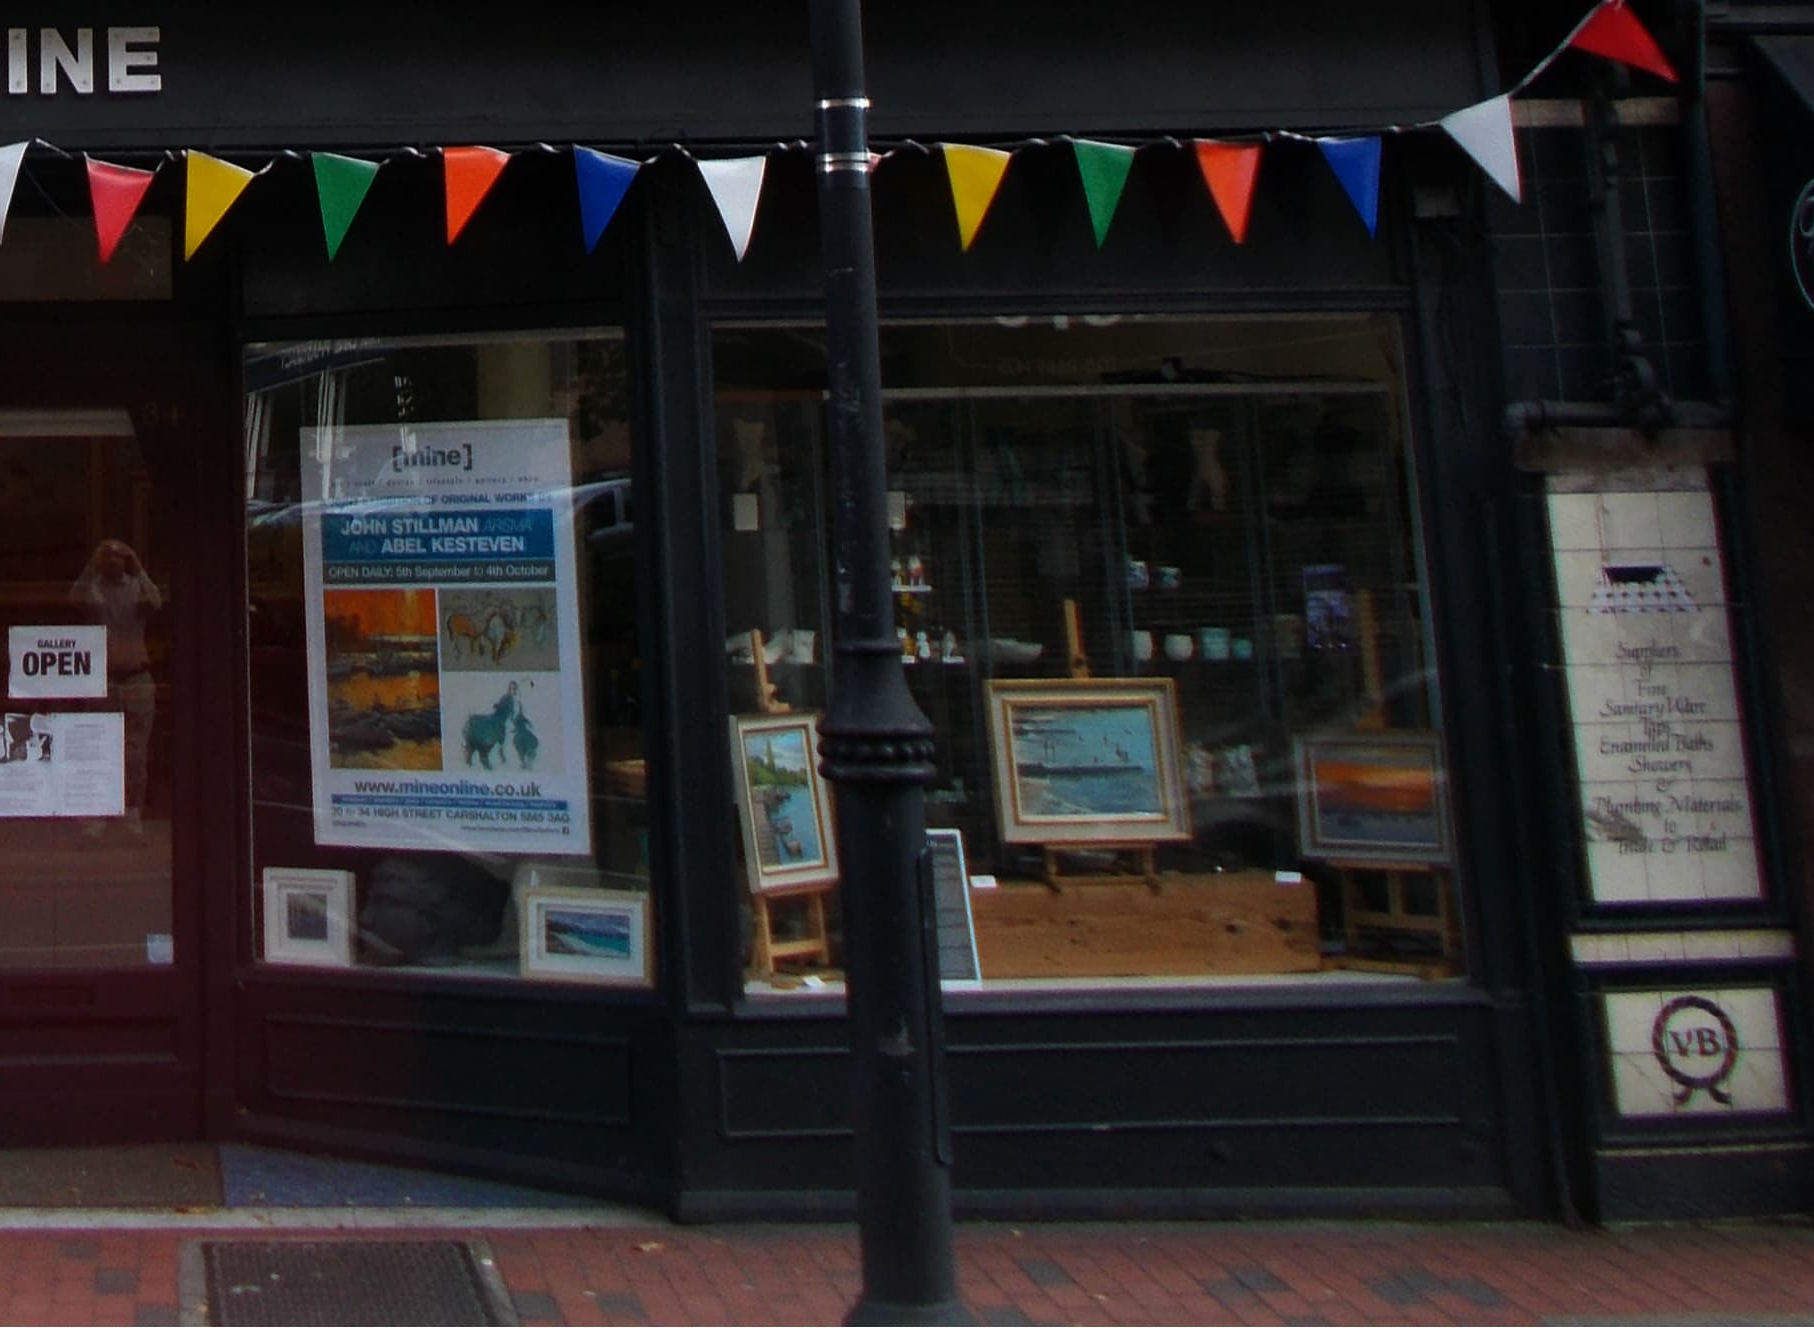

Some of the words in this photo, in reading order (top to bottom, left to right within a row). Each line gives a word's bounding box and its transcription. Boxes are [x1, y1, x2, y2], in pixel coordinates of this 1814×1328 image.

[441, 494, 490, 504] ORIGINAL
[341, 519, 387, 535] JOHN
[392, 518, 478, 533] STILLMAN
[381, 538, 427, 553] ABEL
[432, 536, 524, 552] KESTEVEN
[328, 566, 359, 578] OPEN
[414, 565, 470, 579] September
[505, 564, 548, 576] October
[37, 639, 76, 649] GALLERY
[22, 651, 91, 676] OPEN
[354, 779, 541, 797] www.mineonline.co.uk
[373, 807, 399, 818] HIGH
[402, 808, 442, 819] STREET
[446, 810, 517, 821] CARSHALTON
[1670, 1027, 1721, 1057] VB
